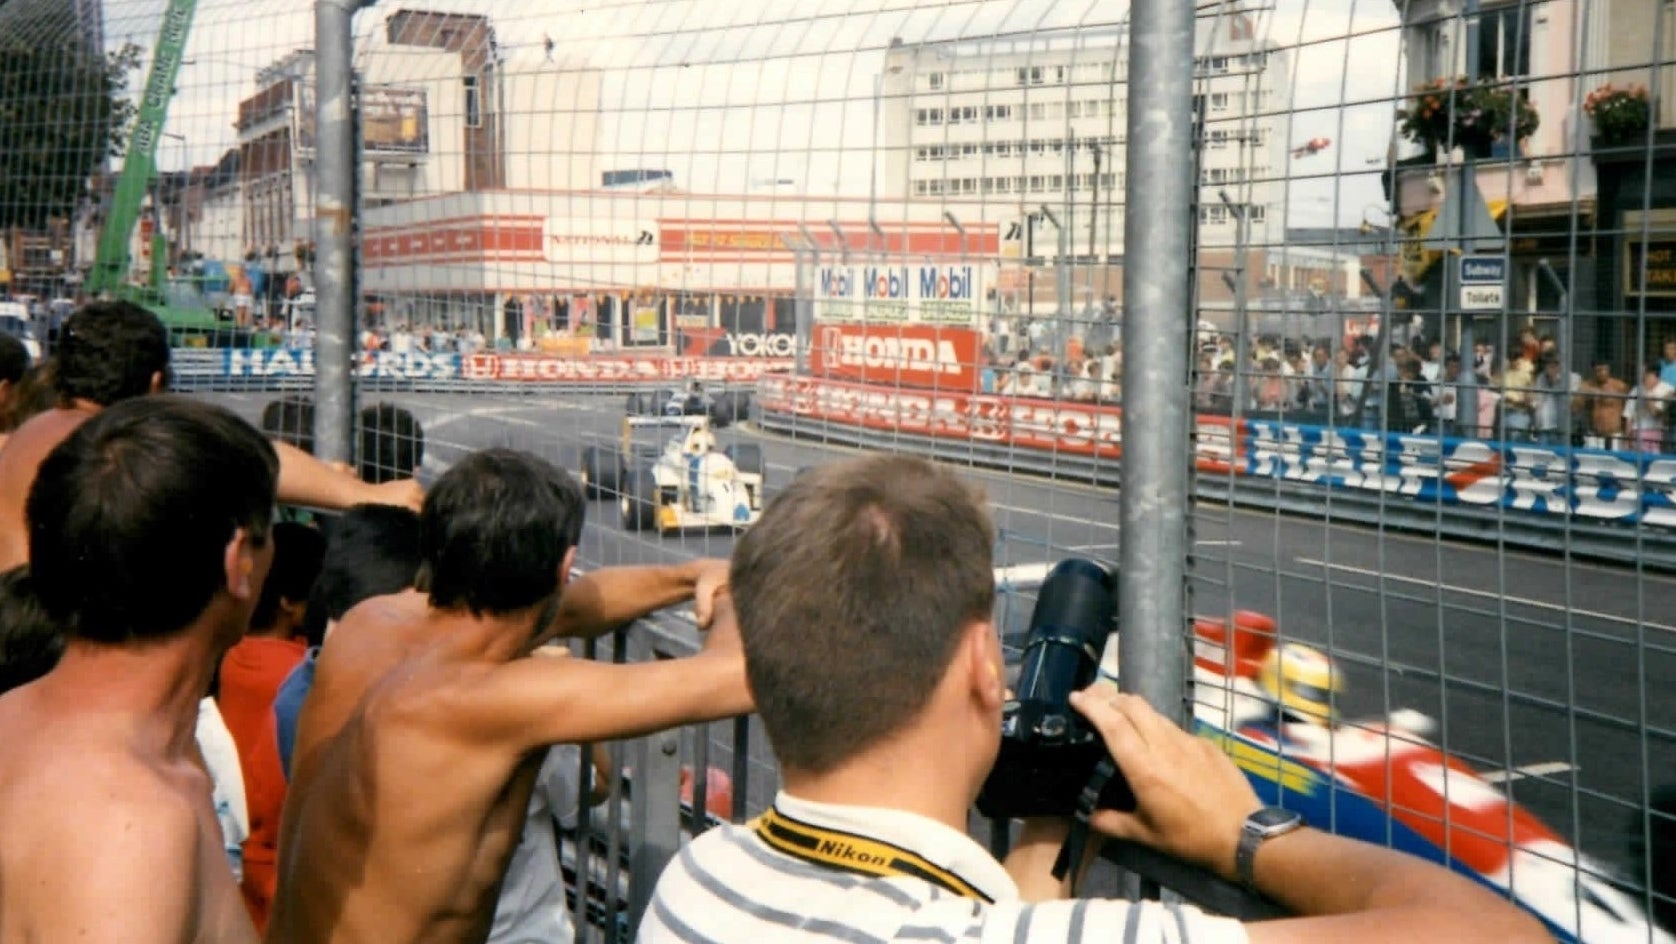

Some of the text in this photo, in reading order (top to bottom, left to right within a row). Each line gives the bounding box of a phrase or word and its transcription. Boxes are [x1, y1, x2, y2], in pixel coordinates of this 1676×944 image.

[864, 267, 908, 298] Mobil
[919, 267, 972, 299] Mobil
[500, 355, 660, 379] HONDA
[840, 334, 962, 374] HONDA
[1252, 423, 1676, 525] HALFORDS
[818, 839, 886, 866] Nikon
